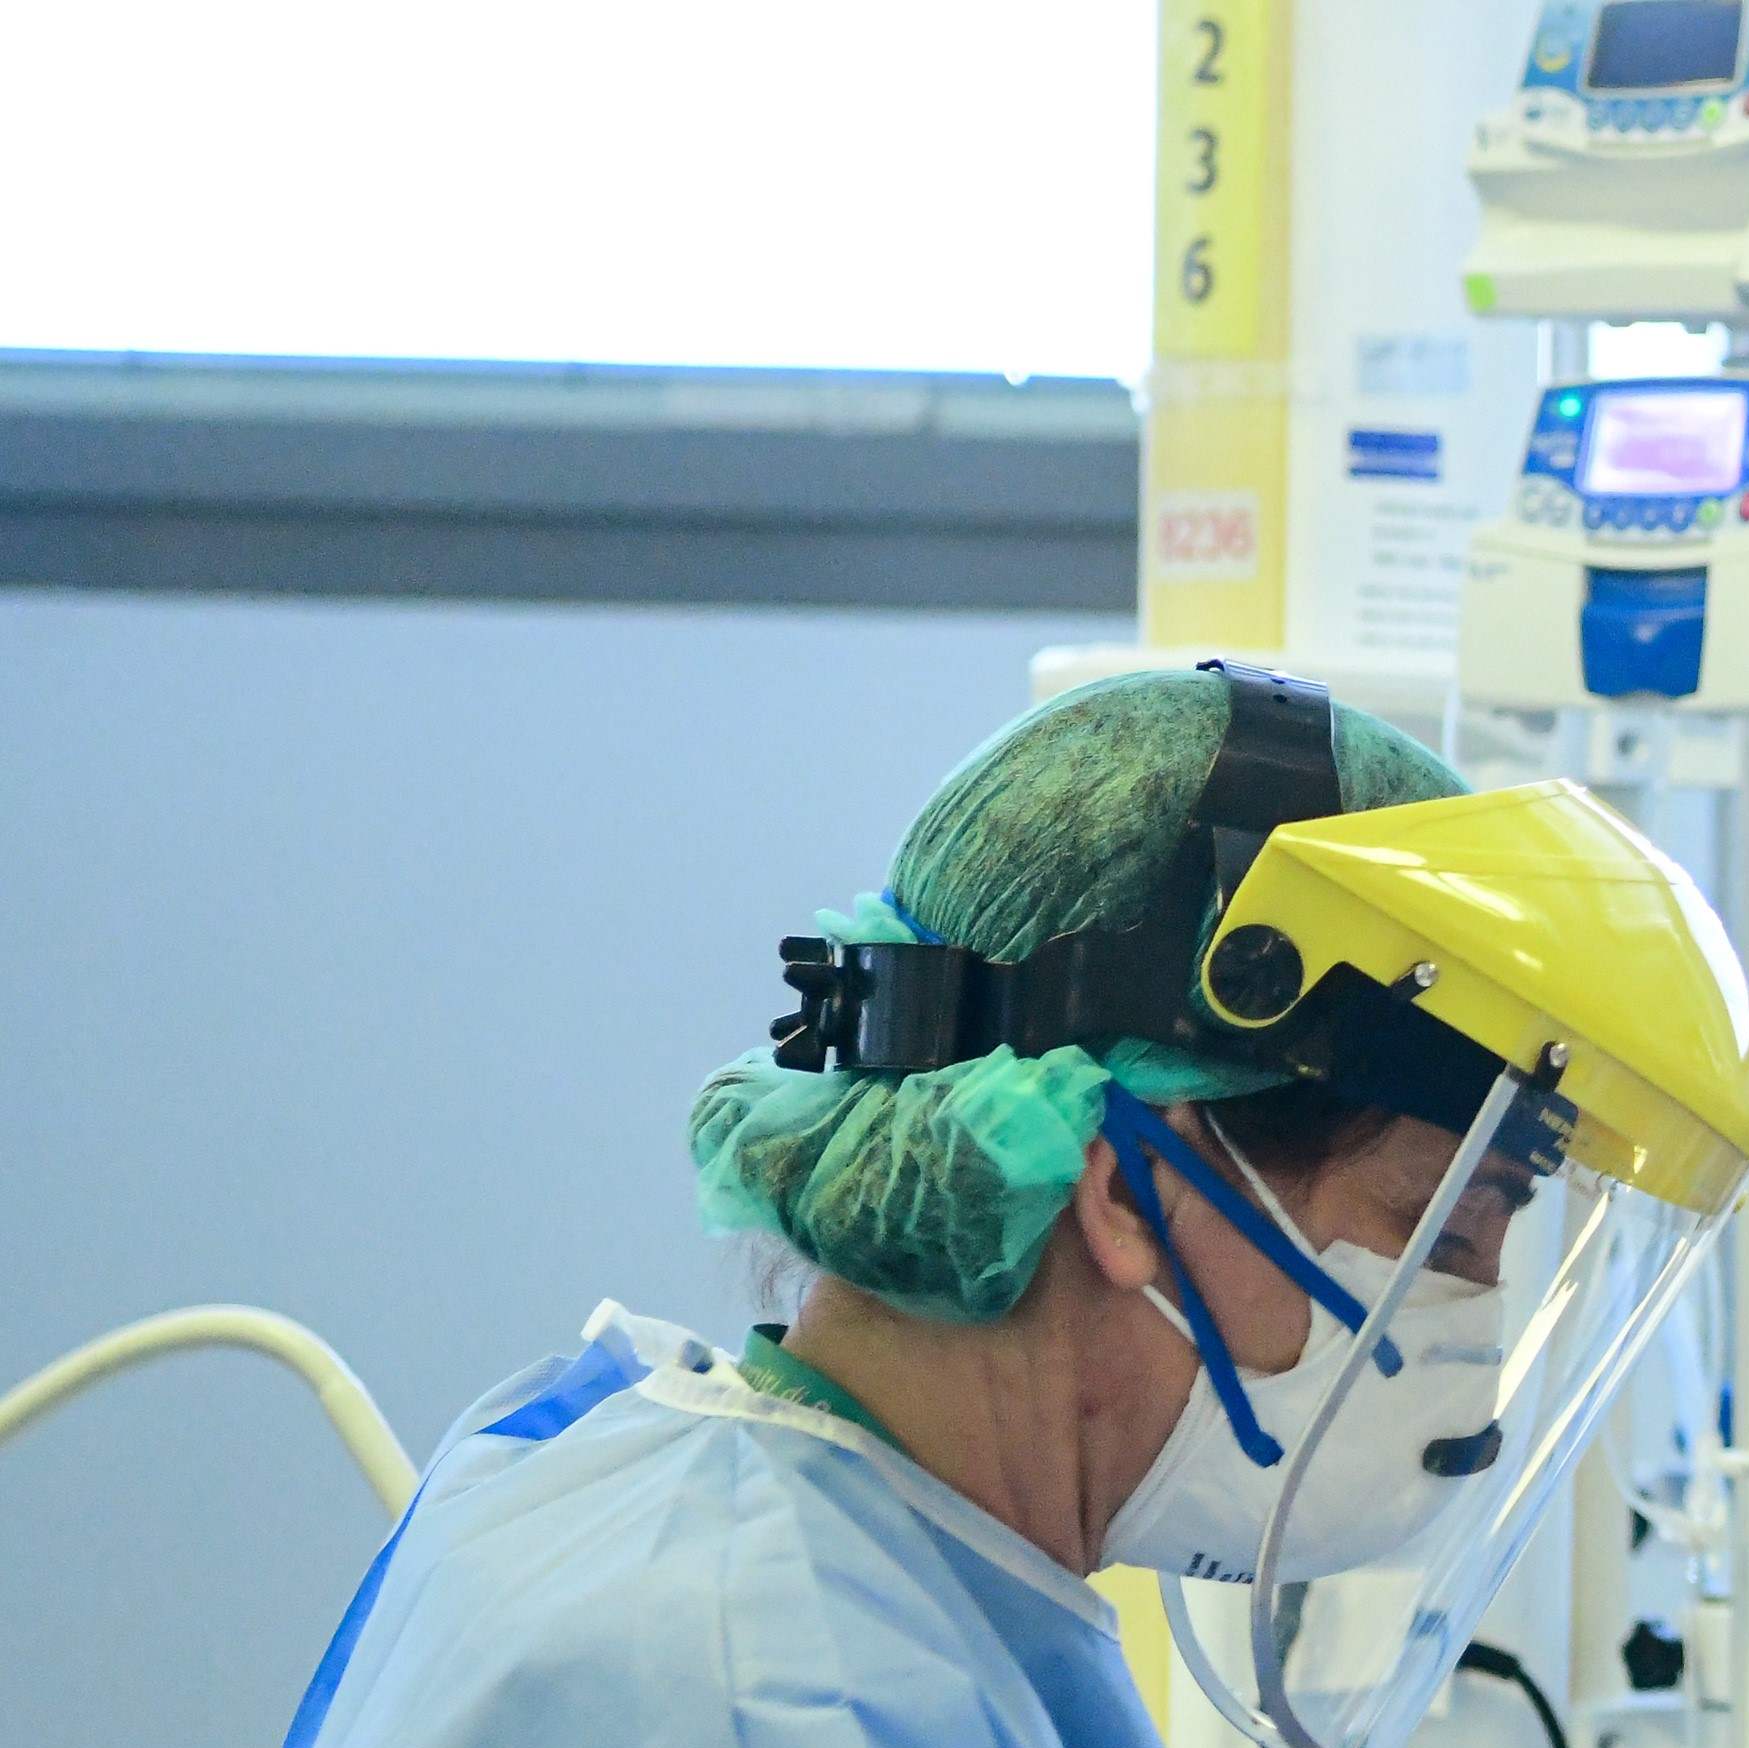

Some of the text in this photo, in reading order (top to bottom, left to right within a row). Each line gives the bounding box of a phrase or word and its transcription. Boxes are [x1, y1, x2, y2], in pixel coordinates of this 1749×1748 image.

[1193, 19, 1223, 84] 2
[1186, 127, 1218, 193] 3
[1182, 235, 1214, 304] 6
